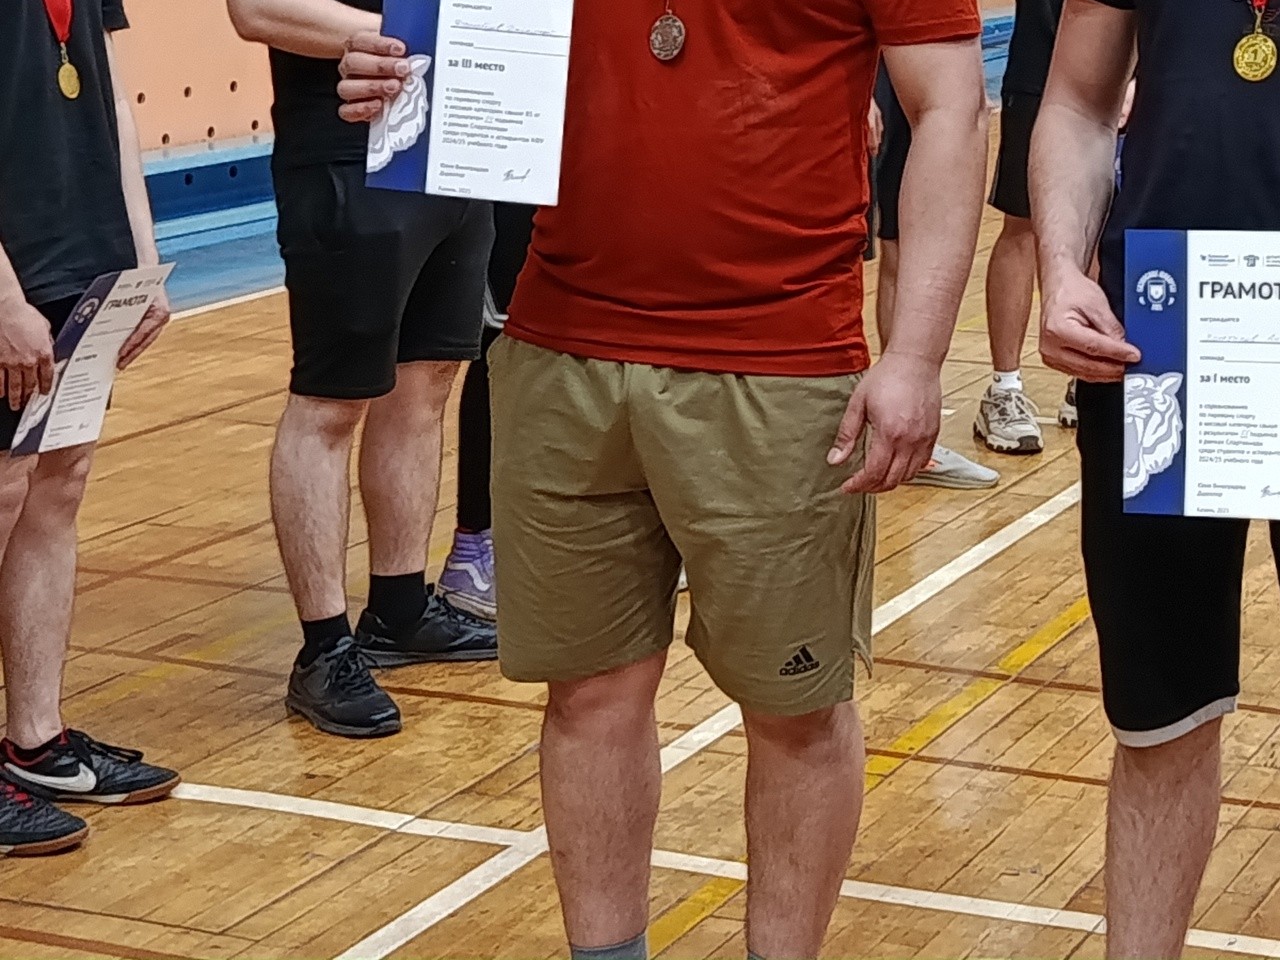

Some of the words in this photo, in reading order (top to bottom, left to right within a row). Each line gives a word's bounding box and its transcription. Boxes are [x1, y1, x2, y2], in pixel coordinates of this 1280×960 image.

[448, 59, 459, 67] за
[474, 62, 505, 72] место
[1200, 375, 1211, 383] за
[1220, 376, 1251, 384] место
[779, 661, 820, 675] adidas
